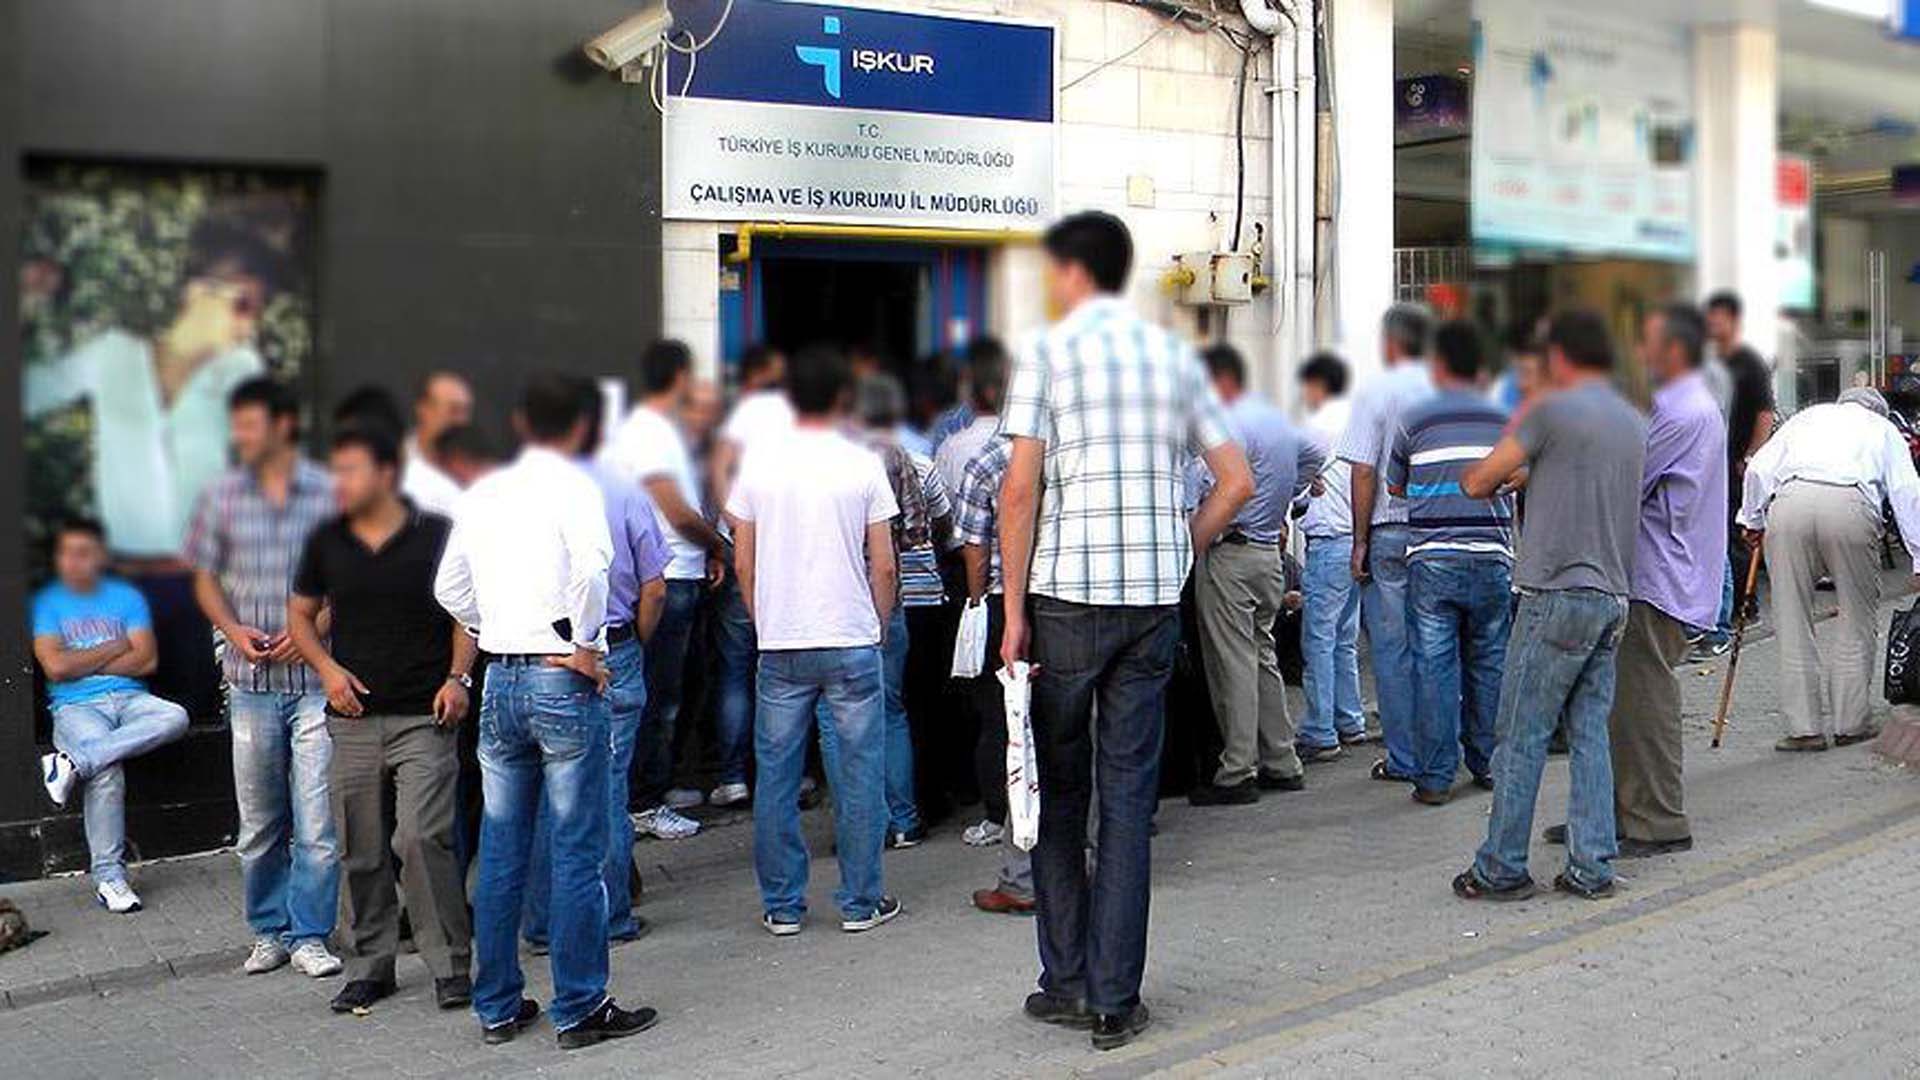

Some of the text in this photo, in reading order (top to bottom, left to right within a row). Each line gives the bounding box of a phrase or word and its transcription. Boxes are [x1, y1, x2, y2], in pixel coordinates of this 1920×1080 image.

[718, 136, 1014, 168] TÜRKİYE İŞ KURUMU GENEL MÜDÜRLÜĞÜ
[690, 184, 1039, 216] ÇALIŞMA VE İŞ KURUMU İL MÜDÜRLÜĞÜ
